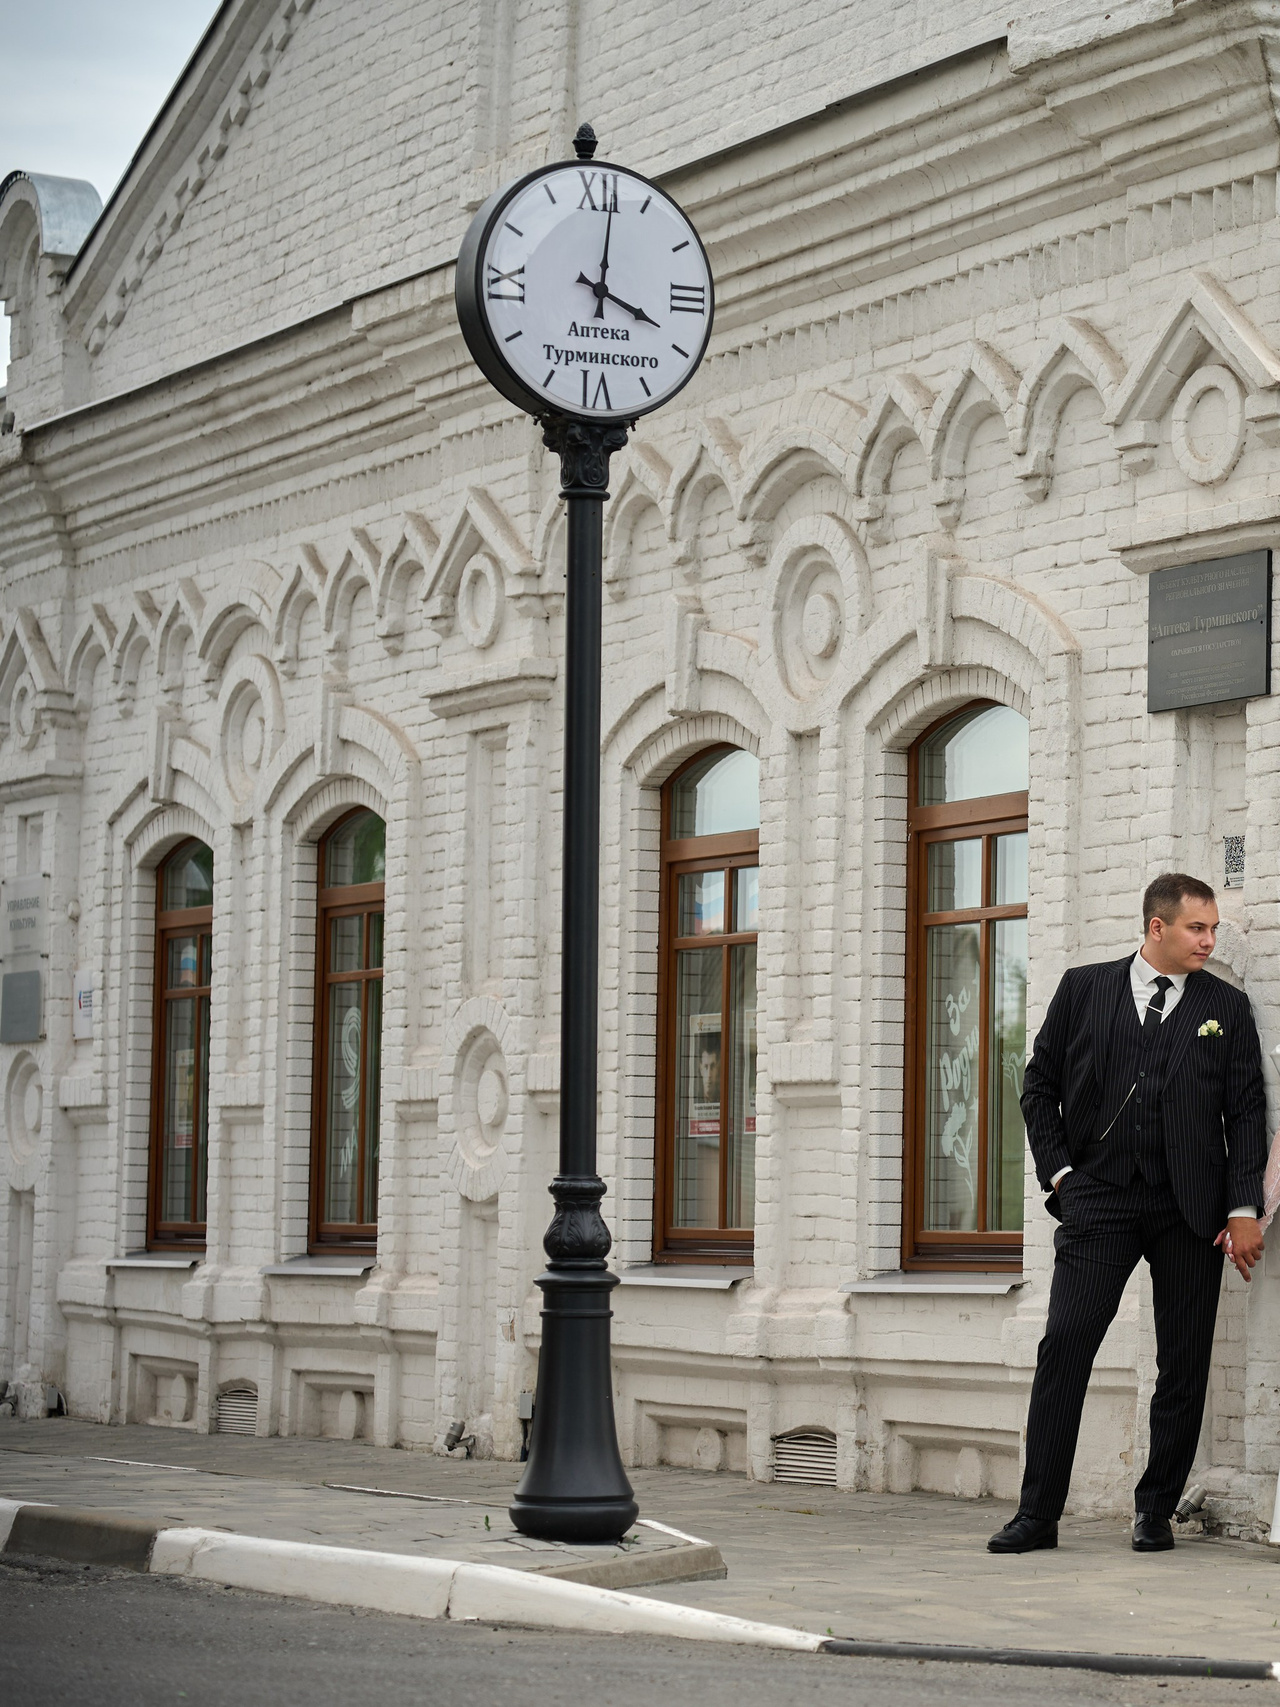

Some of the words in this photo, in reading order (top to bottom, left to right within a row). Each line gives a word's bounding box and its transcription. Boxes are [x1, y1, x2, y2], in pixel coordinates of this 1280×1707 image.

[577, 170, 620, 213] XII
[670, 282, 704, 315] III
[567, 321, 630, 341] Аптека
[543, 344, 659, 369] Турминского
[1157, 579, 1180, 591] ОБЪЕКТ
[1181, 570, 1224, 586] КУЛЬТУРНОГО
[1165, 584, 1217, 600] РЕГИОНАЛЬНОГО
[1217, 578, 1250, 591] ЗНАЧЕНИЯ
[7, 896, 39, 912] УПРАВЛЕНИЕ
